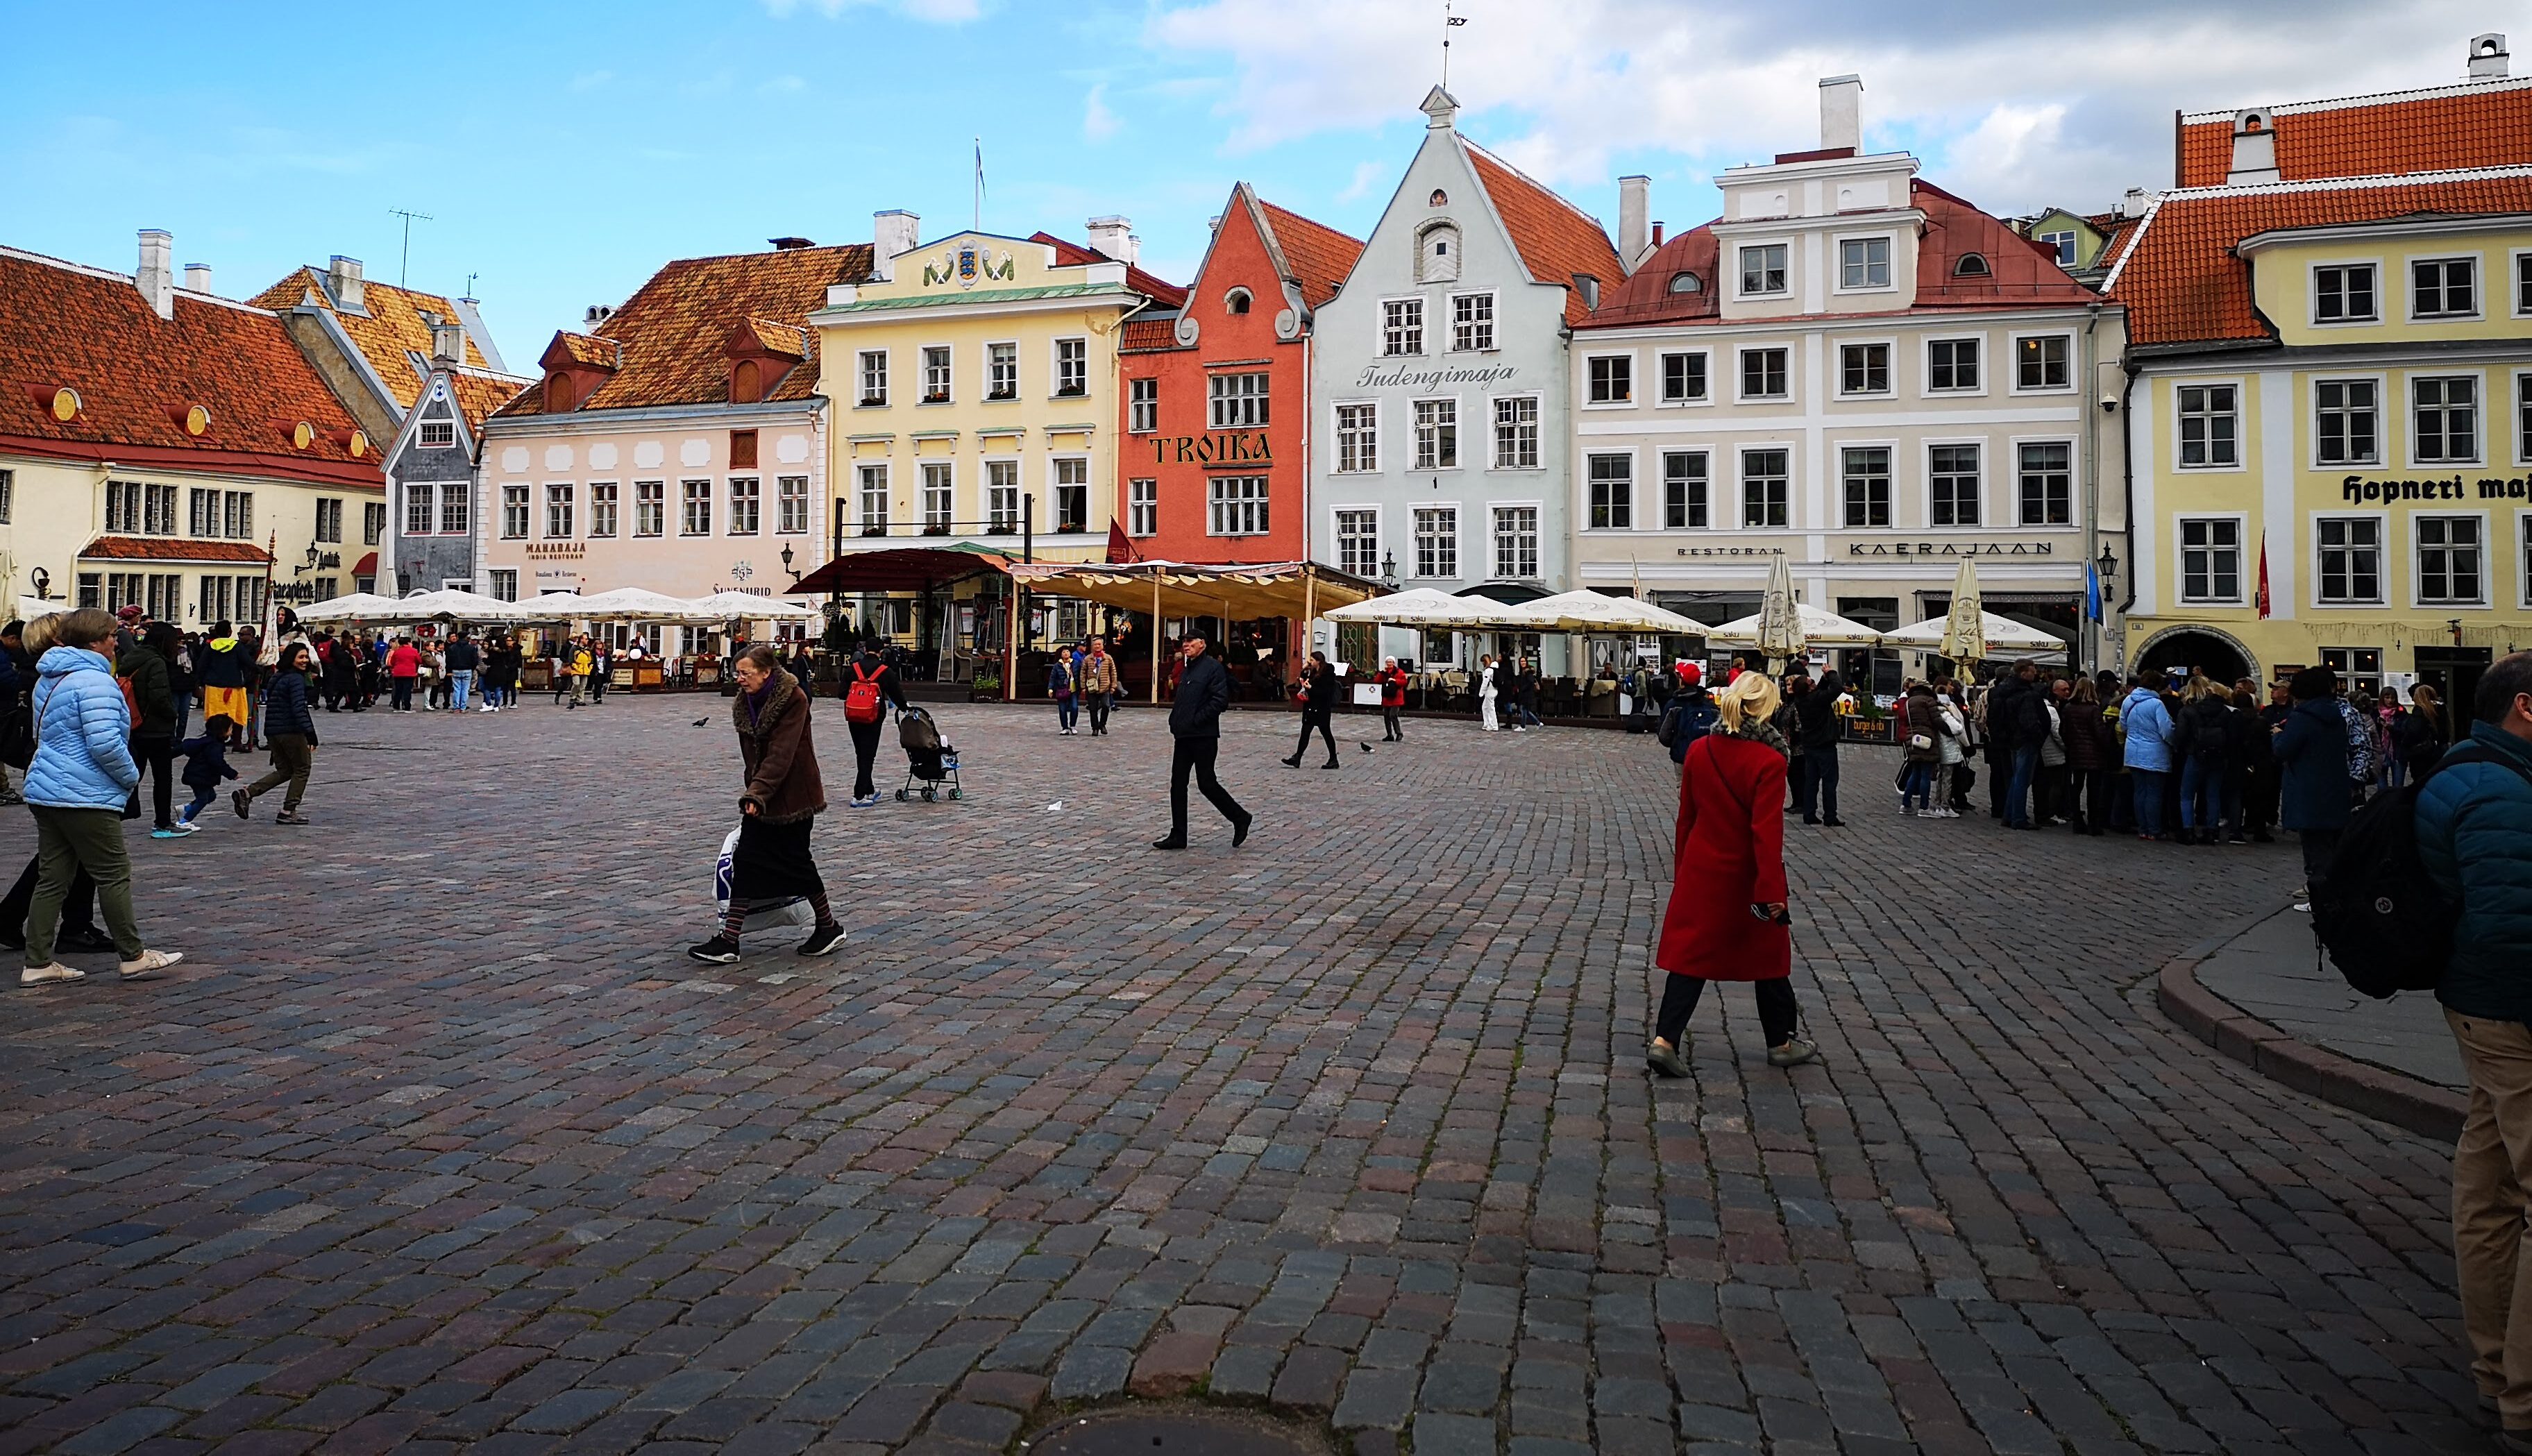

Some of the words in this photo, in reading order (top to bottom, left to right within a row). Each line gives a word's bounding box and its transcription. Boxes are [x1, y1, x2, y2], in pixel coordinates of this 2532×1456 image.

[1356, 363, 1520, 393] Tudengimaja
[1149, 433, 1274, 464] TROIKA
[526, 543, 586, 553] MAHARAJA
[1678, 548, 1784, 556] RESTORAN
[1850, 543, 2052, 555] KAERAJAAN
